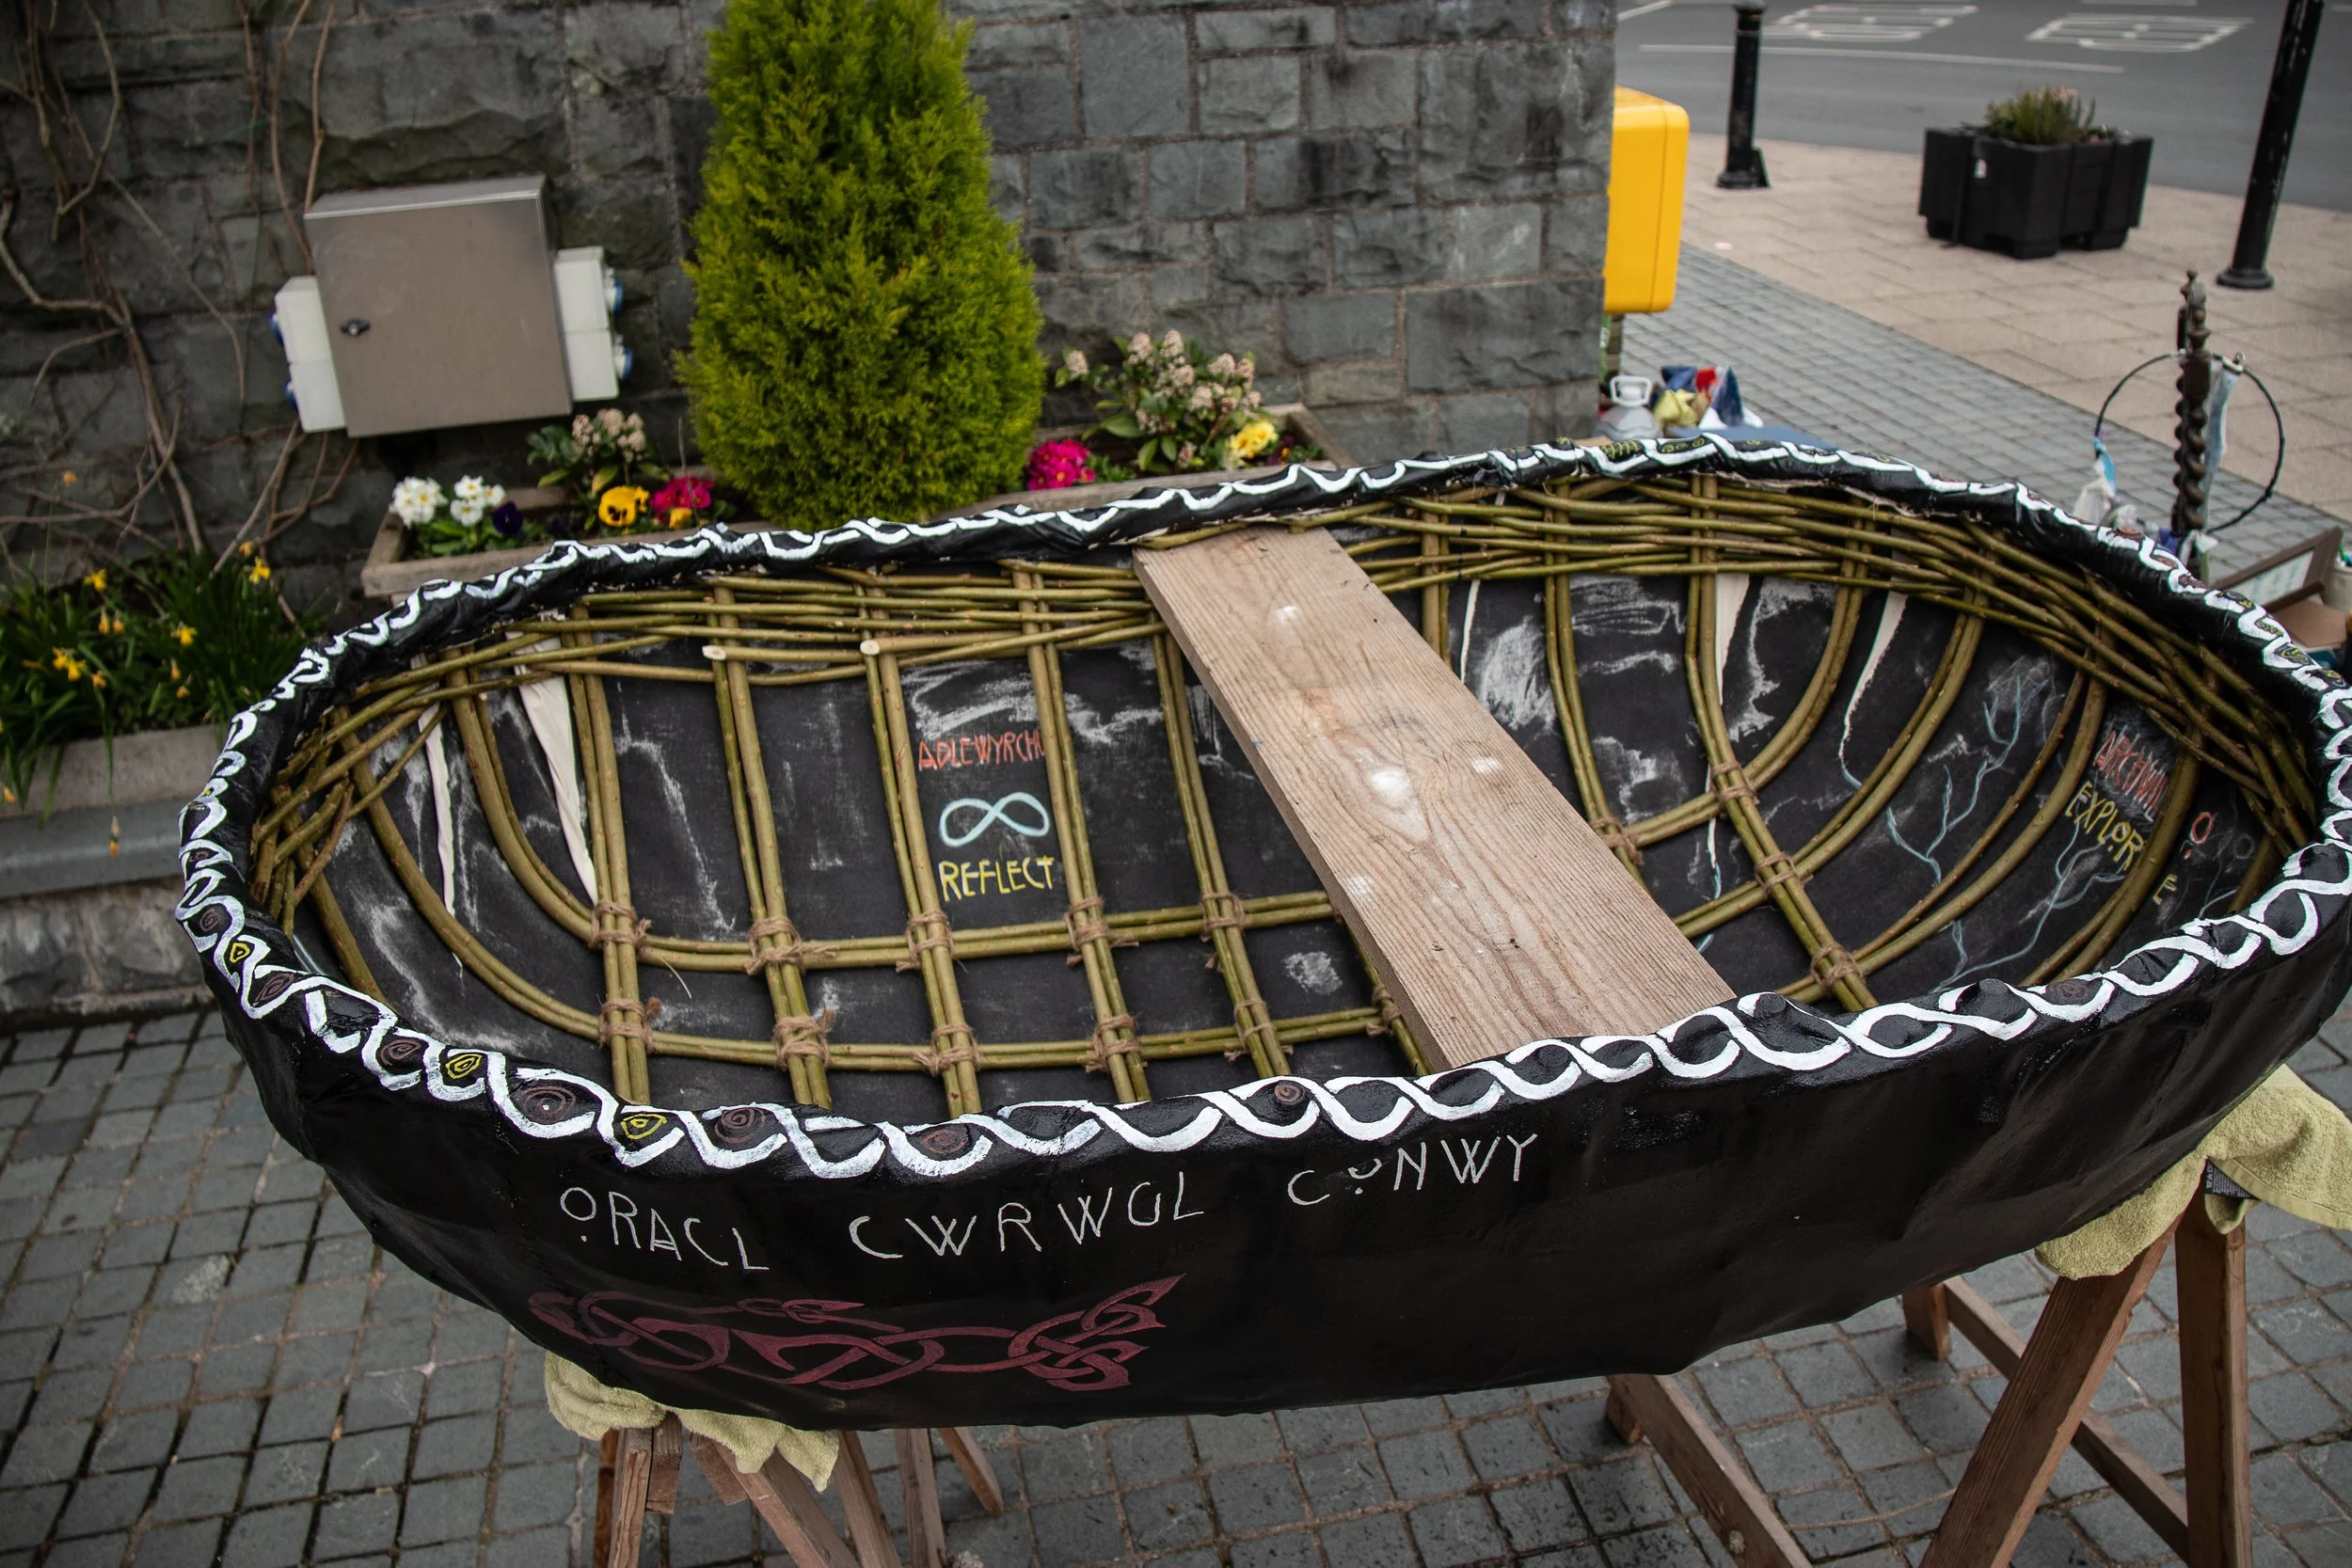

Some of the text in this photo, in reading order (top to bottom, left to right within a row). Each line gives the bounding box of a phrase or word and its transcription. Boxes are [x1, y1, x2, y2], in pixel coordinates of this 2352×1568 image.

[939, 855, 1055, 902] REFLECT
[560, 1186, 770, 1272] ORACL
[849, 1171, 1205, 1259] CWRWGL
